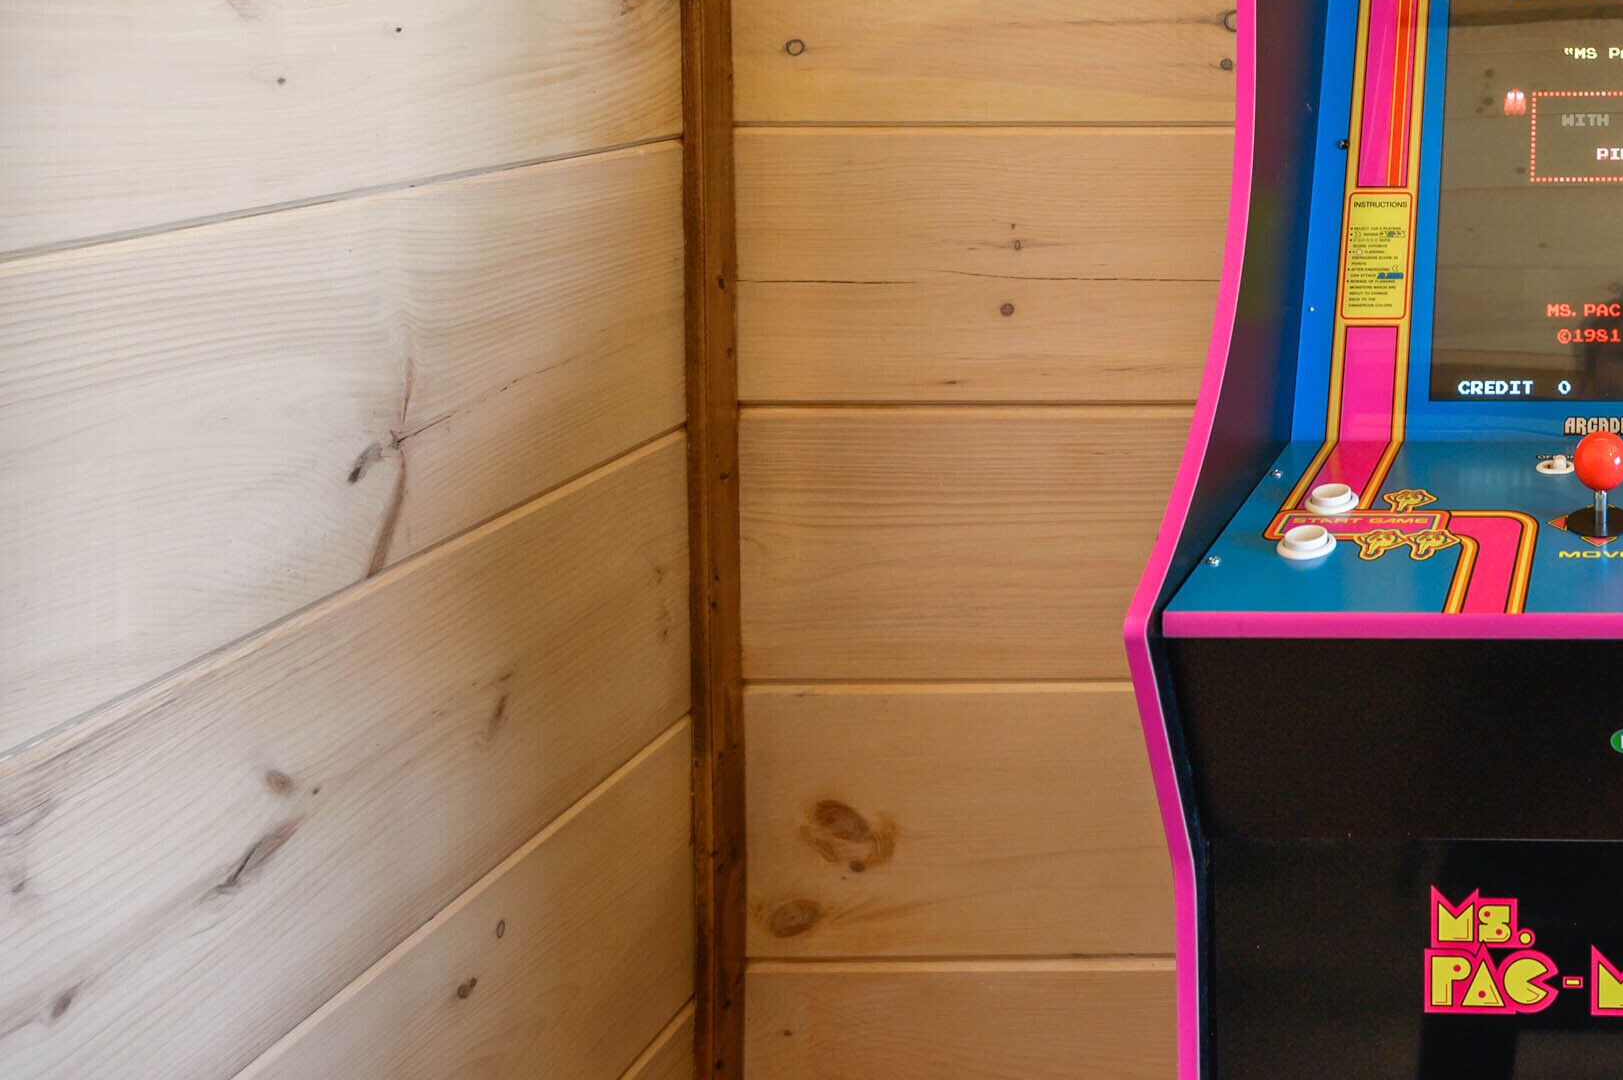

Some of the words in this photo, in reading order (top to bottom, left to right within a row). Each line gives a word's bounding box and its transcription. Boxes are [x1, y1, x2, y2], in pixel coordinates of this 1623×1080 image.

[1561, 113, 1610, 127] WITH
[1353, 201, 1408, 209] INSTRUCTIONS
[1547, 303, 1577, 317] MS.
[1457, 380, 1534, 396] CREDIT
[1368, 517, 1430, 525] GAME
